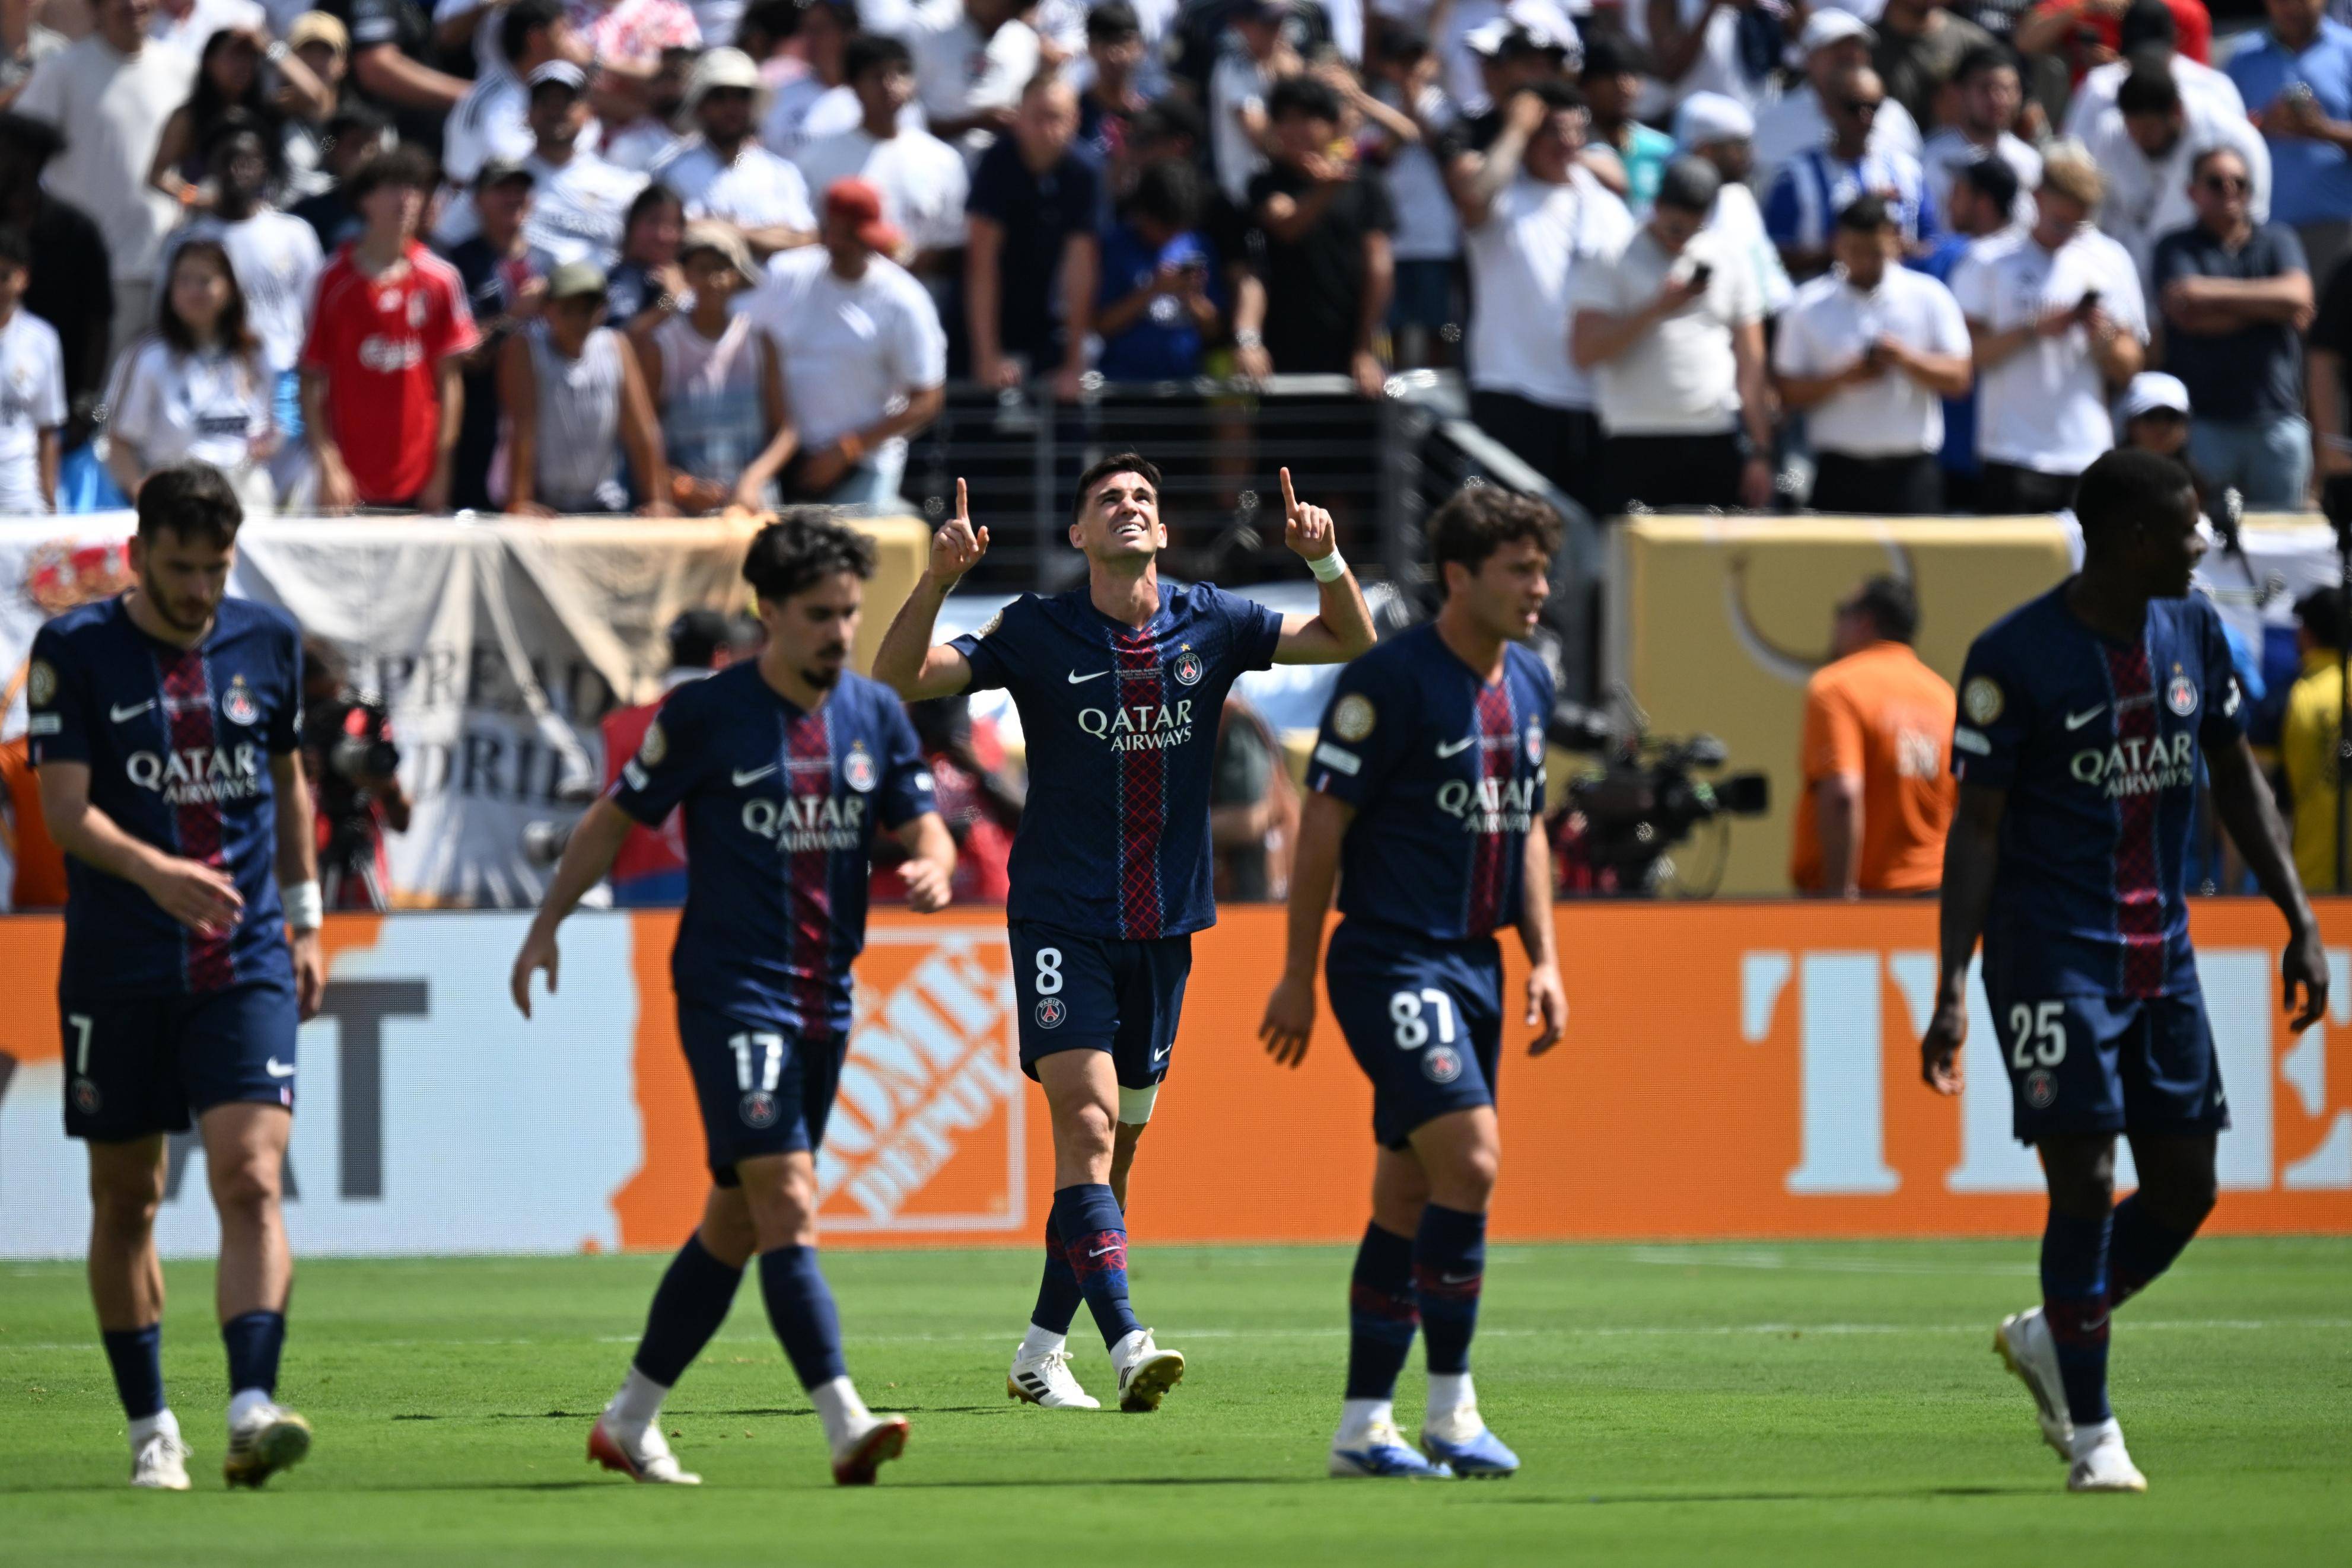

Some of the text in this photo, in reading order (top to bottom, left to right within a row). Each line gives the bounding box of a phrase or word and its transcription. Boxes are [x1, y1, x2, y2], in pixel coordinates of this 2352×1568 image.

[1177, 654, 1196, 664] PARIS
[1078, 699, 1192, 740] QATAR
[1110, 725, 1192, 751] AIRWAYS
[126, 742, 257, 792] QATAR
[2070, 730, 2193, 786] QATAR
[162, 775, 259, 805] AIRWAYS
[2104, 766, 2193, 798] AIRWAYS
[741, 795, 865, 840] QATAR
[1035, 947, 1063, 995] 8
[1039, 999, 1060, 1009] PARIS
[1389, 987, 1456, 1050] 87
[68, 1013, 93, 1075] 7
[2010, 1000, 2067, 1068] 25
[728, 1031, 784, 1091] 17
